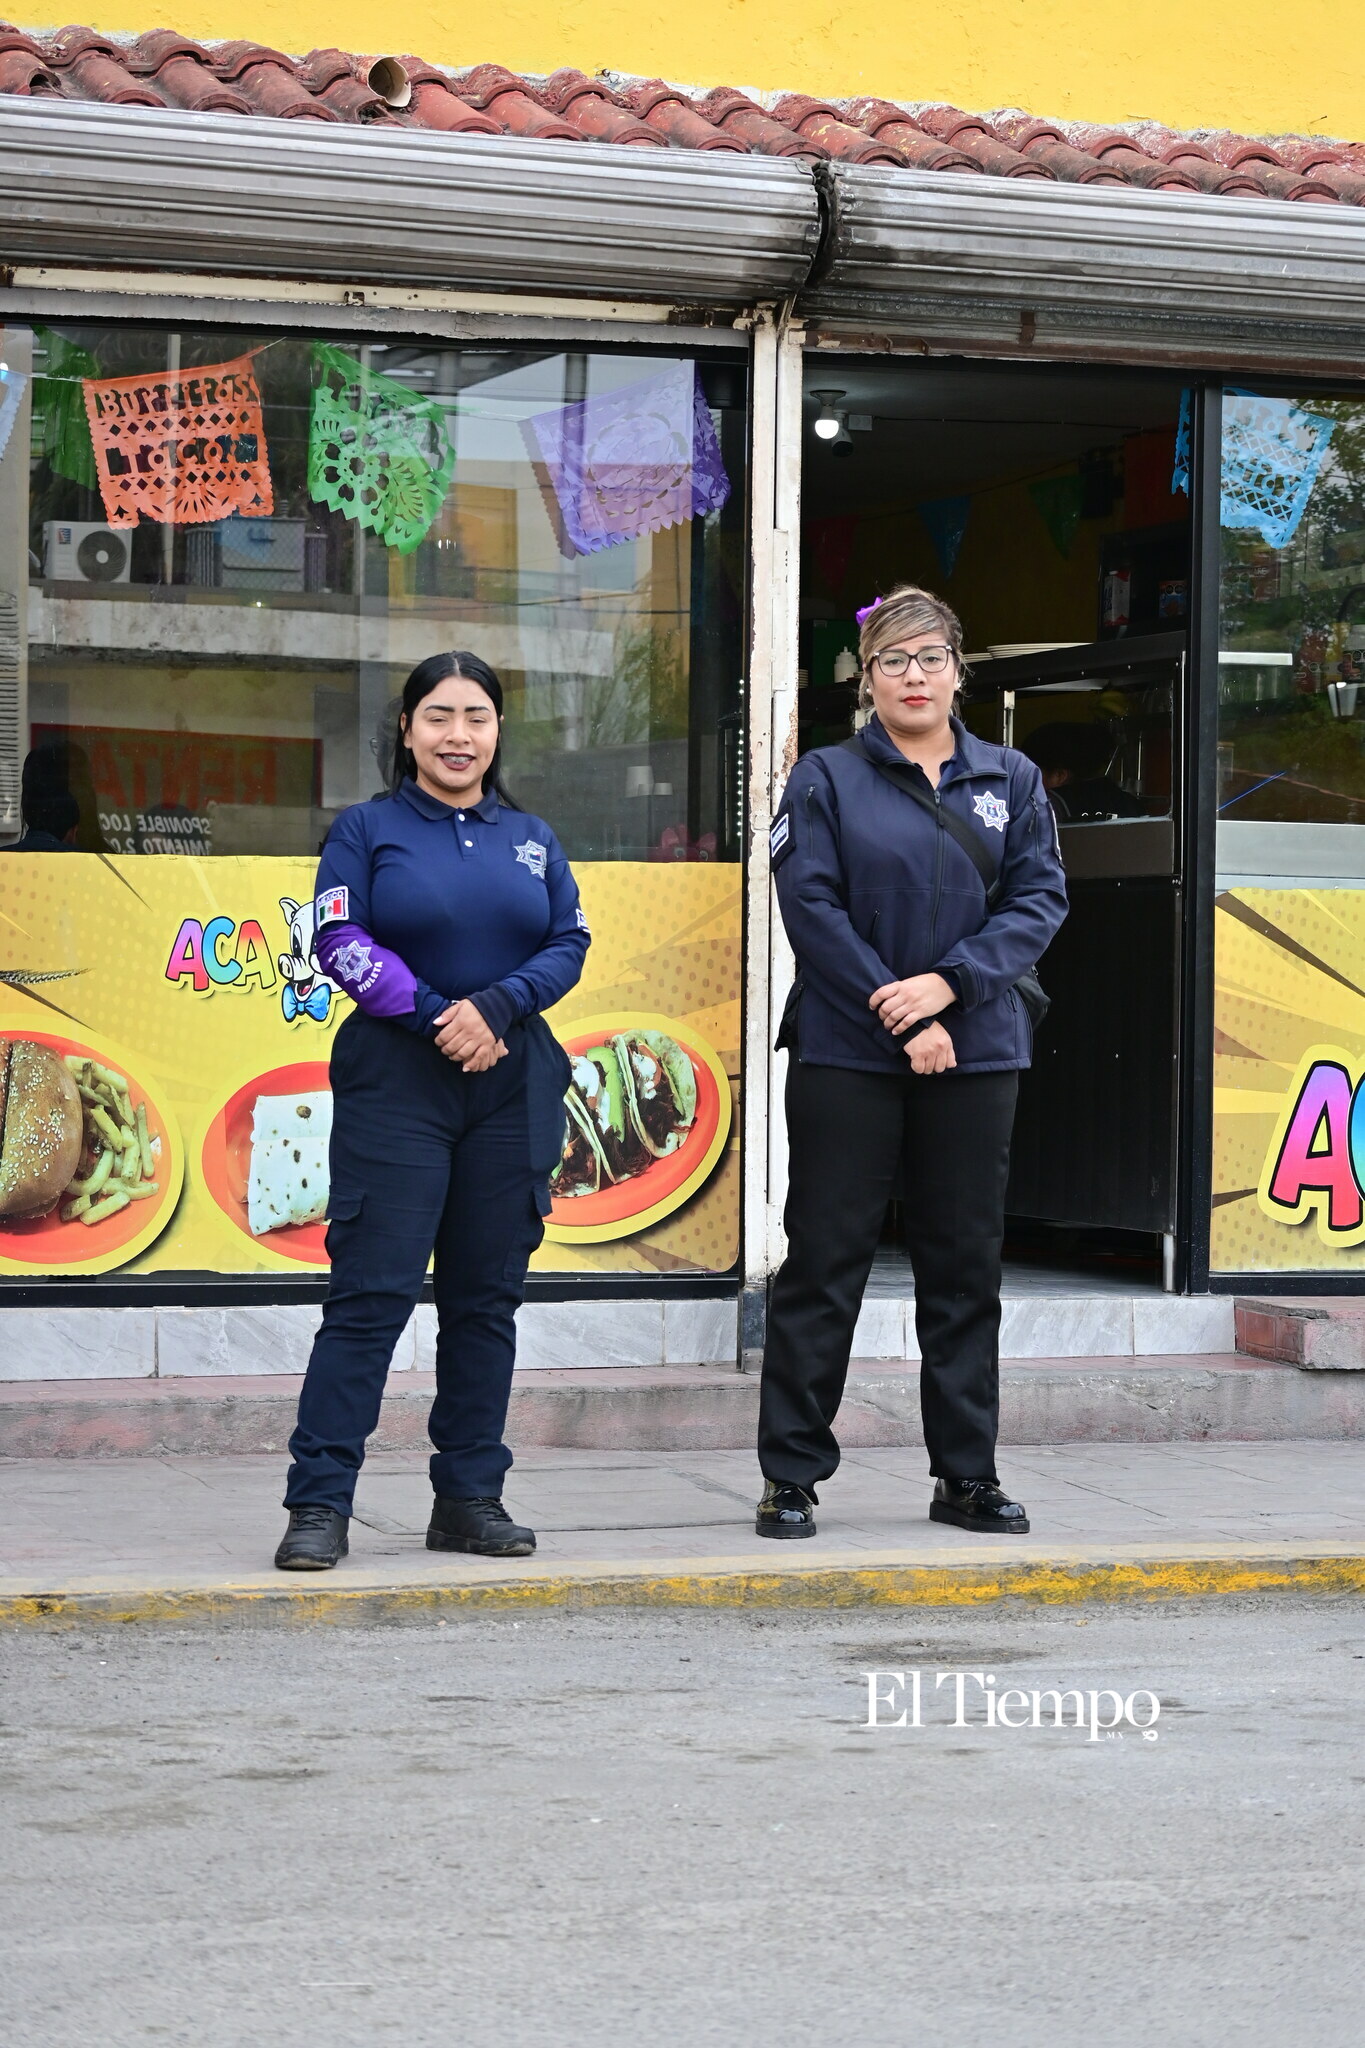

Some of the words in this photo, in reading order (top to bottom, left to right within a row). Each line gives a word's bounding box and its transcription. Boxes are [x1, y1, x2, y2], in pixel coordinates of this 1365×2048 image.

[165, 916, 277, 991] ACA
[357, 961, 383, 993] VIOLETA
[1268, 1060, 1365, 1231] A
